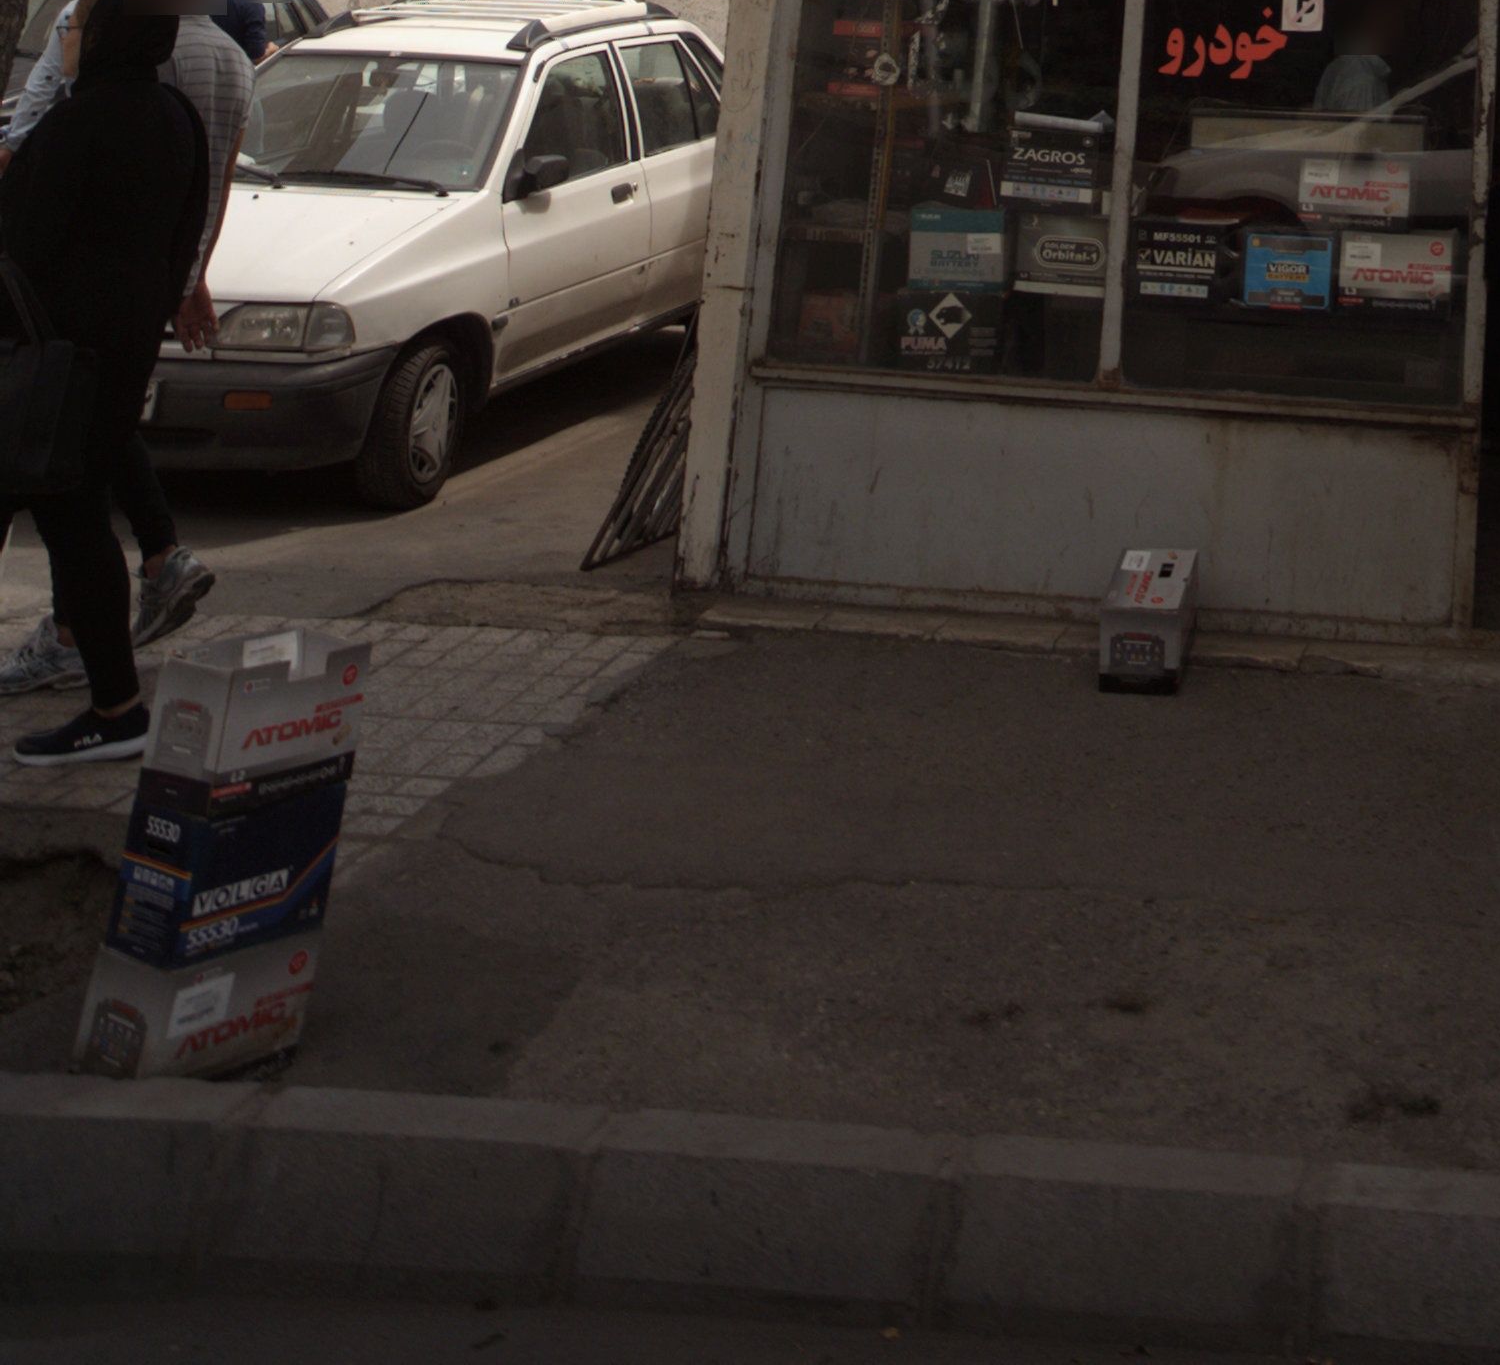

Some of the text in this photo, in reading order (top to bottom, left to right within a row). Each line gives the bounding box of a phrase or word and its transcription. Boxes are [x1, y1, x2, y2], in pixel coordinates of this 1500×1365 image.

[1156, 5, 1289, 80] خودرو
[1012, 147, 1086, 166] ZAGROS
[1310, 185, 1390, 201] ATOMIC
[1153, 231, 1202, 244] MF55501
[1042, 248, 1098, 263] Orbital-1
[1352, 268, 1435, 285] ATOMIC
[900, 336, 947, 351] PUMA
[241, 710, 343, 751] ATOMIC
[194, 870, 288, 916] VOLGA
[185, 917, 240, 949] 55530
[174, 1002, 287, 1062] ATOMIC
